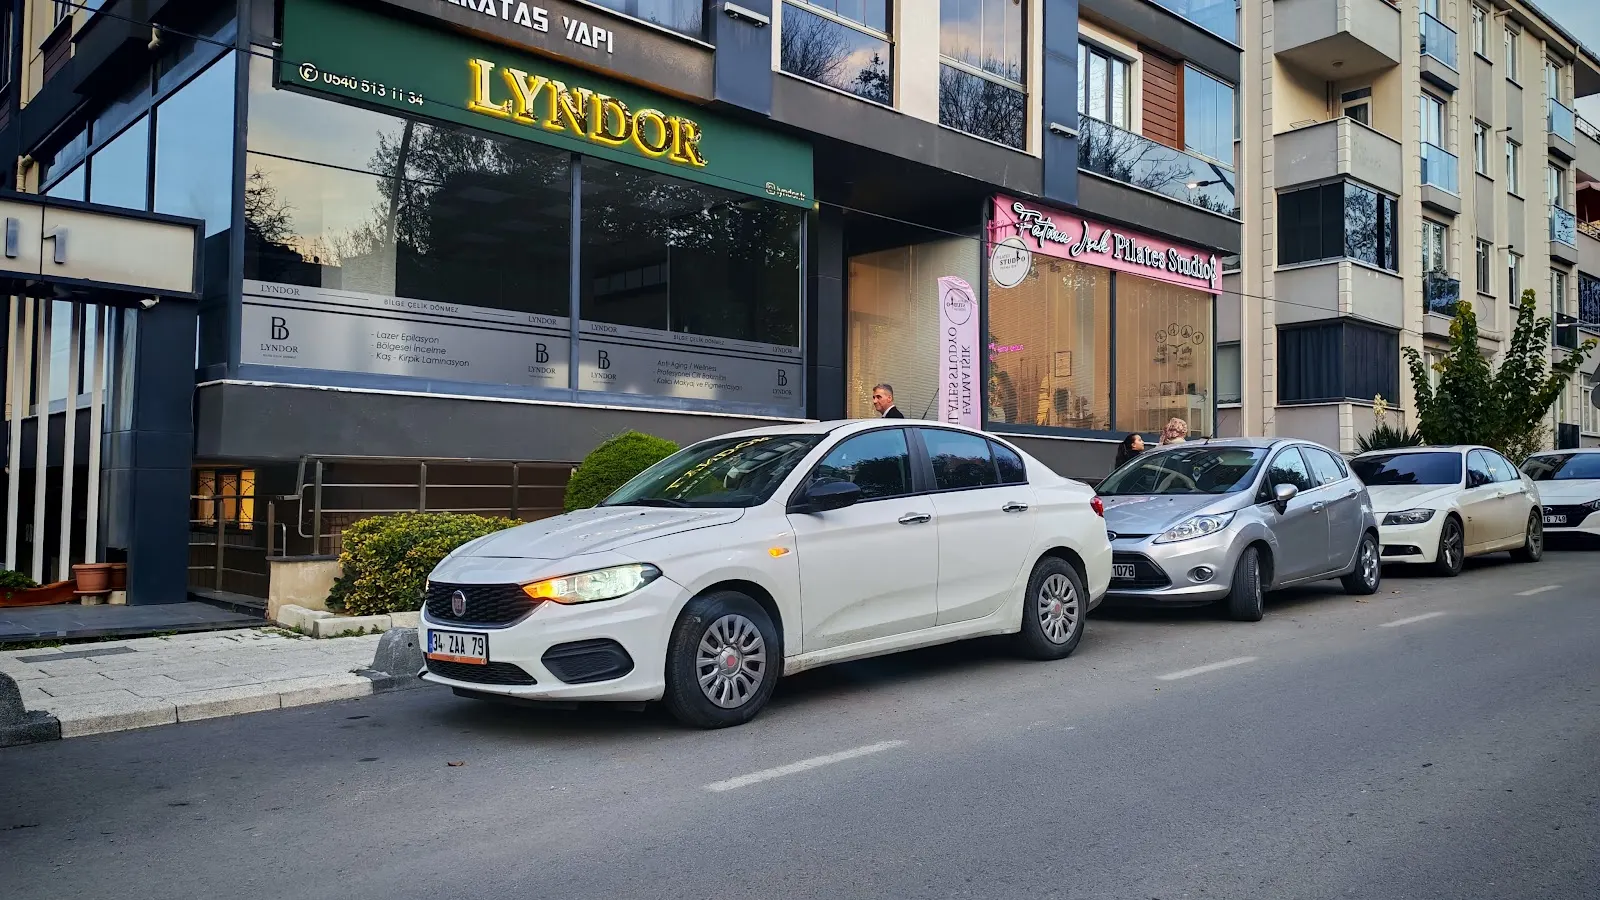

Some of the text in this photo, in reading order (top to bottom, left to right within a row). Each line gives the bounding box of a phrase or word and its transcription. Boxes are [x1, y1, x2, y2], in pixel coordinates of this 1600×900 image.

[563, 16, 613, 53] YAPI
[323, 72, 424, 106] 0540 513 11 34
[468, 58, 708, 166] LYNDOR
[1013, 202, 1072, 248] Fatma
[1113, 233, 1166, 269] Pilates
[1168, 248, 1210, 280] Studio
[261, 284, 300, 296] LYNDOR
[383, 299, 459, 313] BİLGE ÇELİK DÖNMEZ
[528, 315, 557, 325] LYNDOR
[591, 324, 618, 333] LYNDOR
[377, 331, 440, 344] Lazer Epilasyon
[260, 343, 299, 354] LYNDOR
[376, 342, 447, 355] Bölgesel İncelme
[772, 346, 793, 354] LYNDOR
[376, 352, 391, 361] Kaş
[422, 355, 470, 367] Laminasyon
[528, 366, 556, 374] LYNDOR
[591, 372, 617, 380] LYNDOR
[1112, 565, 1135, 577] 1078
[432, 633, 484, 656] 34 ZAA 79
